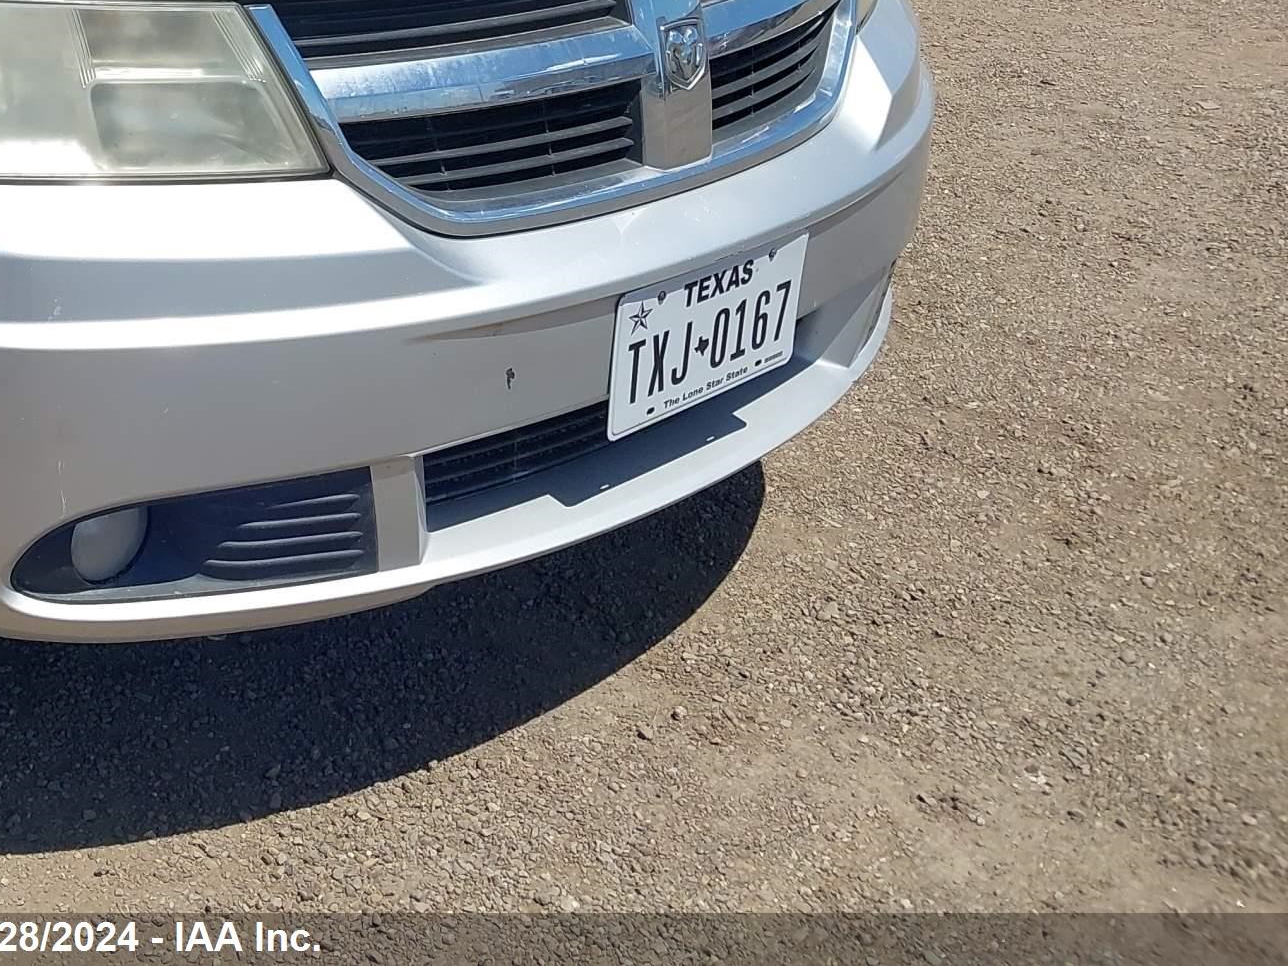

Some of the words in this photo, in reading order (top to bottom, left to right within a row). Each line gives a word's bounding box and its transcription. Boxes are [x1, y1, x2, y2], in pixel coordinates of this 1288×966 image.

[684, 259, 754, 307] TEXAS
[663, 397, 680, 409] The
[683, 386, 703, 401] Lone
[706, 377, 724, 390] Star
[726, 366, 748, 381] State
